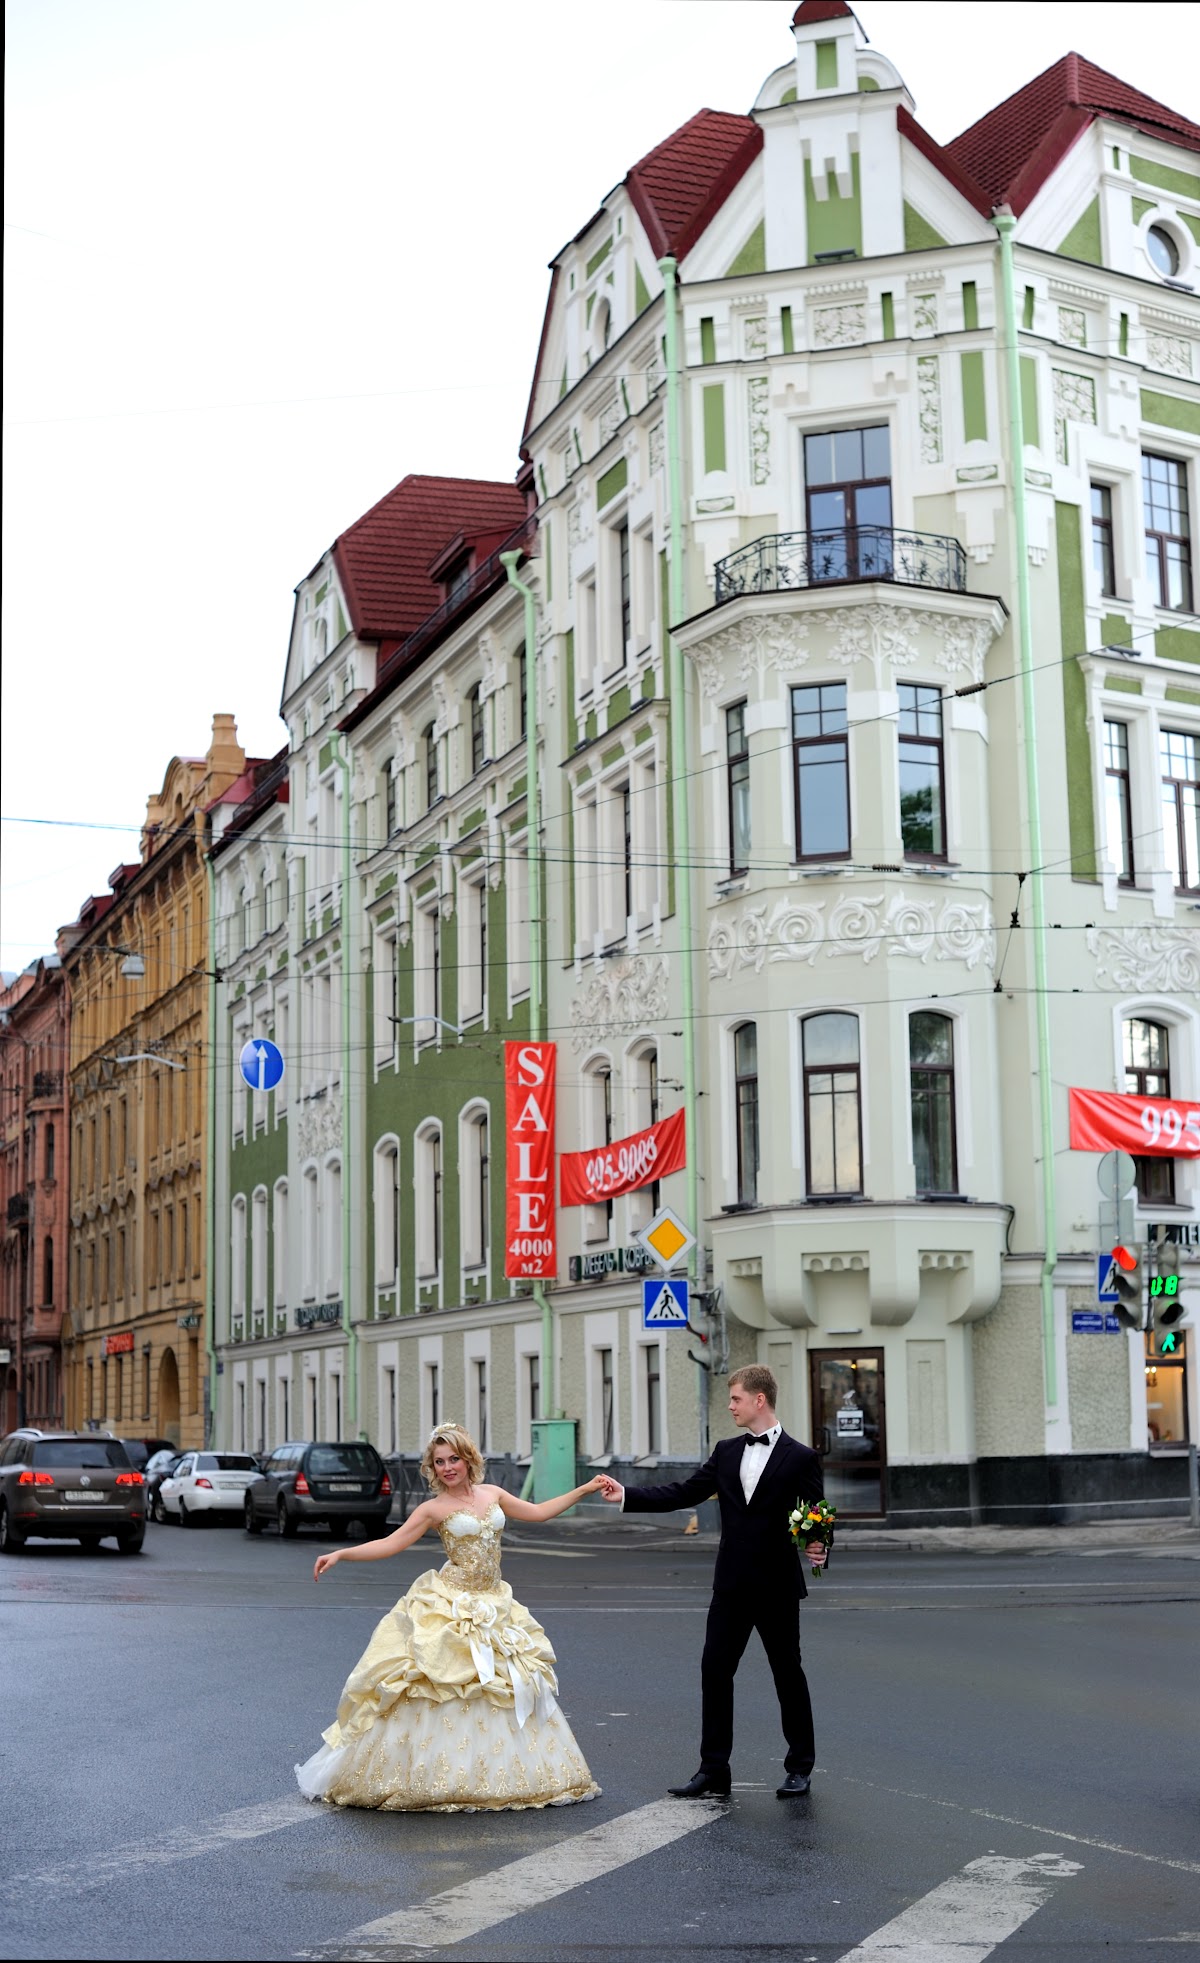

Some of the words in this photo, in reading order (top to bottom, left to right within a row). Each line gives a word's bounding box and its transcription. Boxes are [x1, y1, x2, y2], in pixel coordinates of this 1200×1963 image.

[512, 1046, 549, 1233] SALE
[509, 1238, 553, 1257] 4000
[583, 1252, 615, 1275] МЕБЕЛЬ
